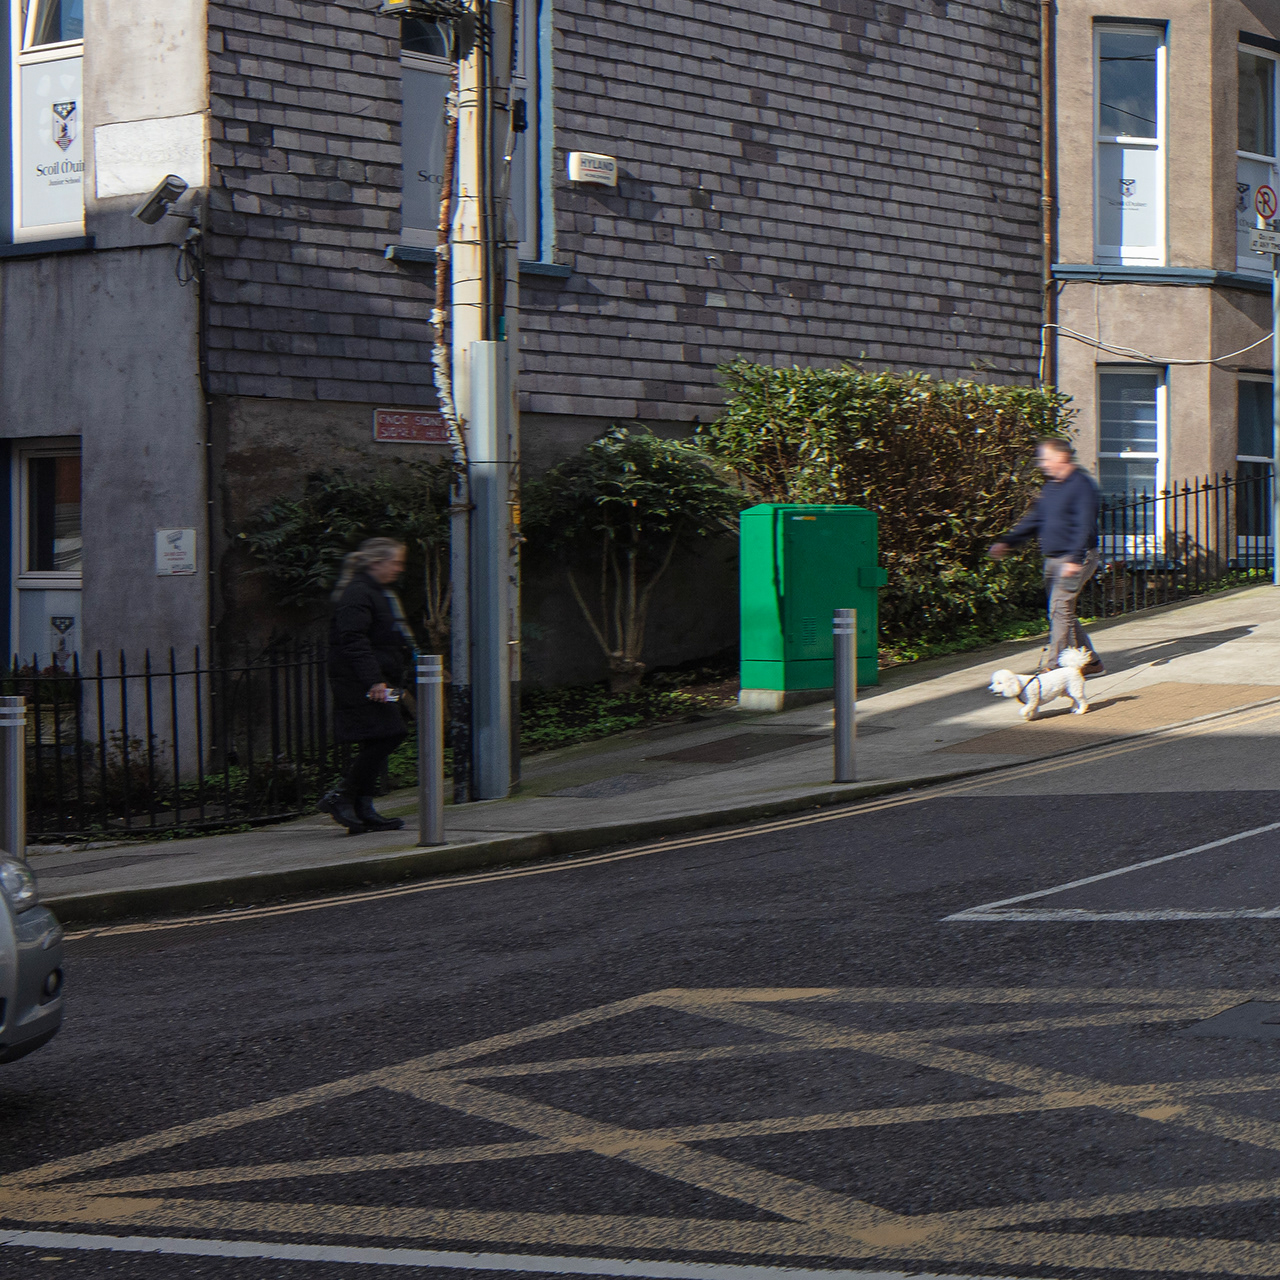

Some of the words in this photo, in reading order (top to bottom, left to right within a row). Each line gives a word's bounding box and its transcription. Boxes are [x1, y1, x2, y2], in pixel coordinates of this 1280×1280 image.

[36, 161, 60, 177] Scoil
[580, 158, 614, 172] HYLAND
[417, 169, 445, 185] Sco
[415, 416, 445, 427] SIDNE
